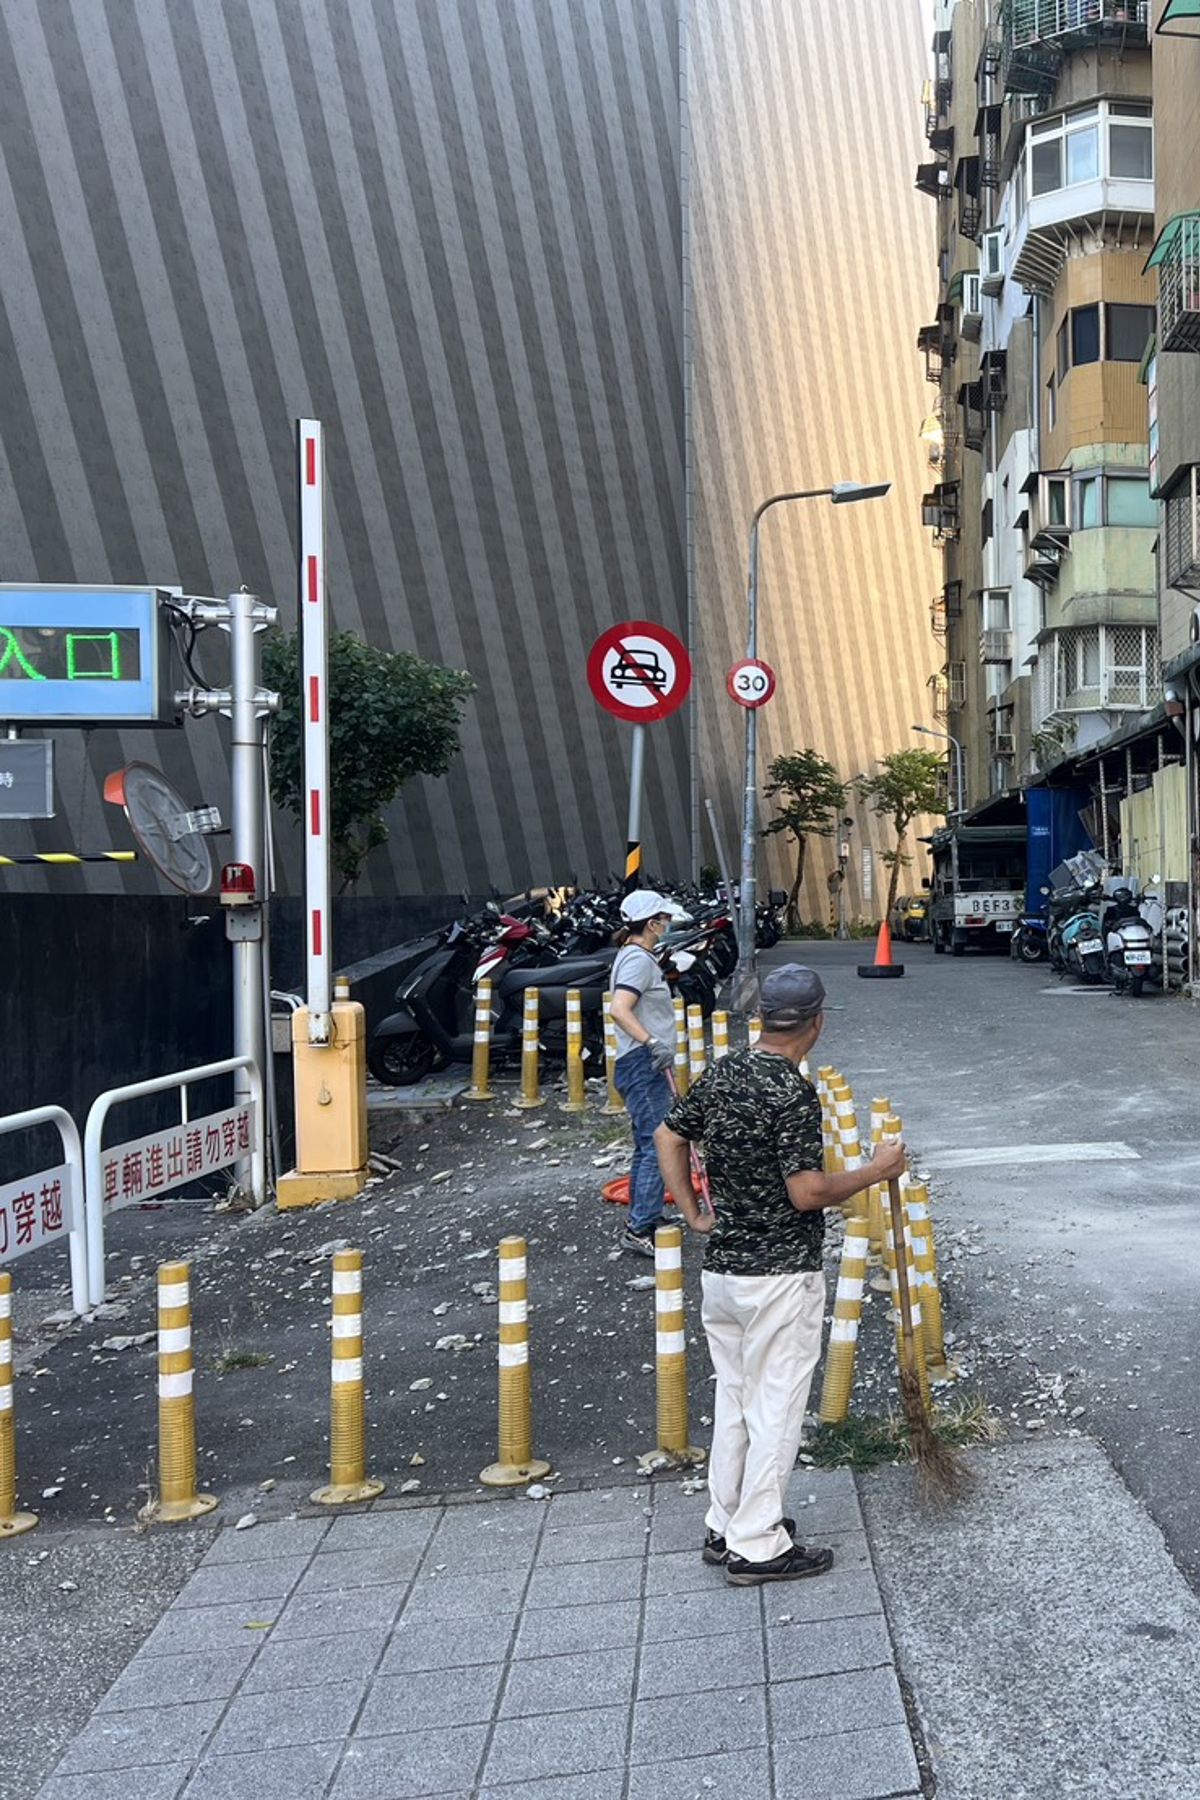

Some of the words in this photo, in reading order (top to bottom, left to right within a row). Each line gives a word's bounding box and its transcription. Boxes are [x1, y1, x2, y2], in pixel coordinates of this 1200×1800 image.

[737, 675, 766, 692] 30
[103, 1110, 250, 1204] 車輛進出請勿穿越
